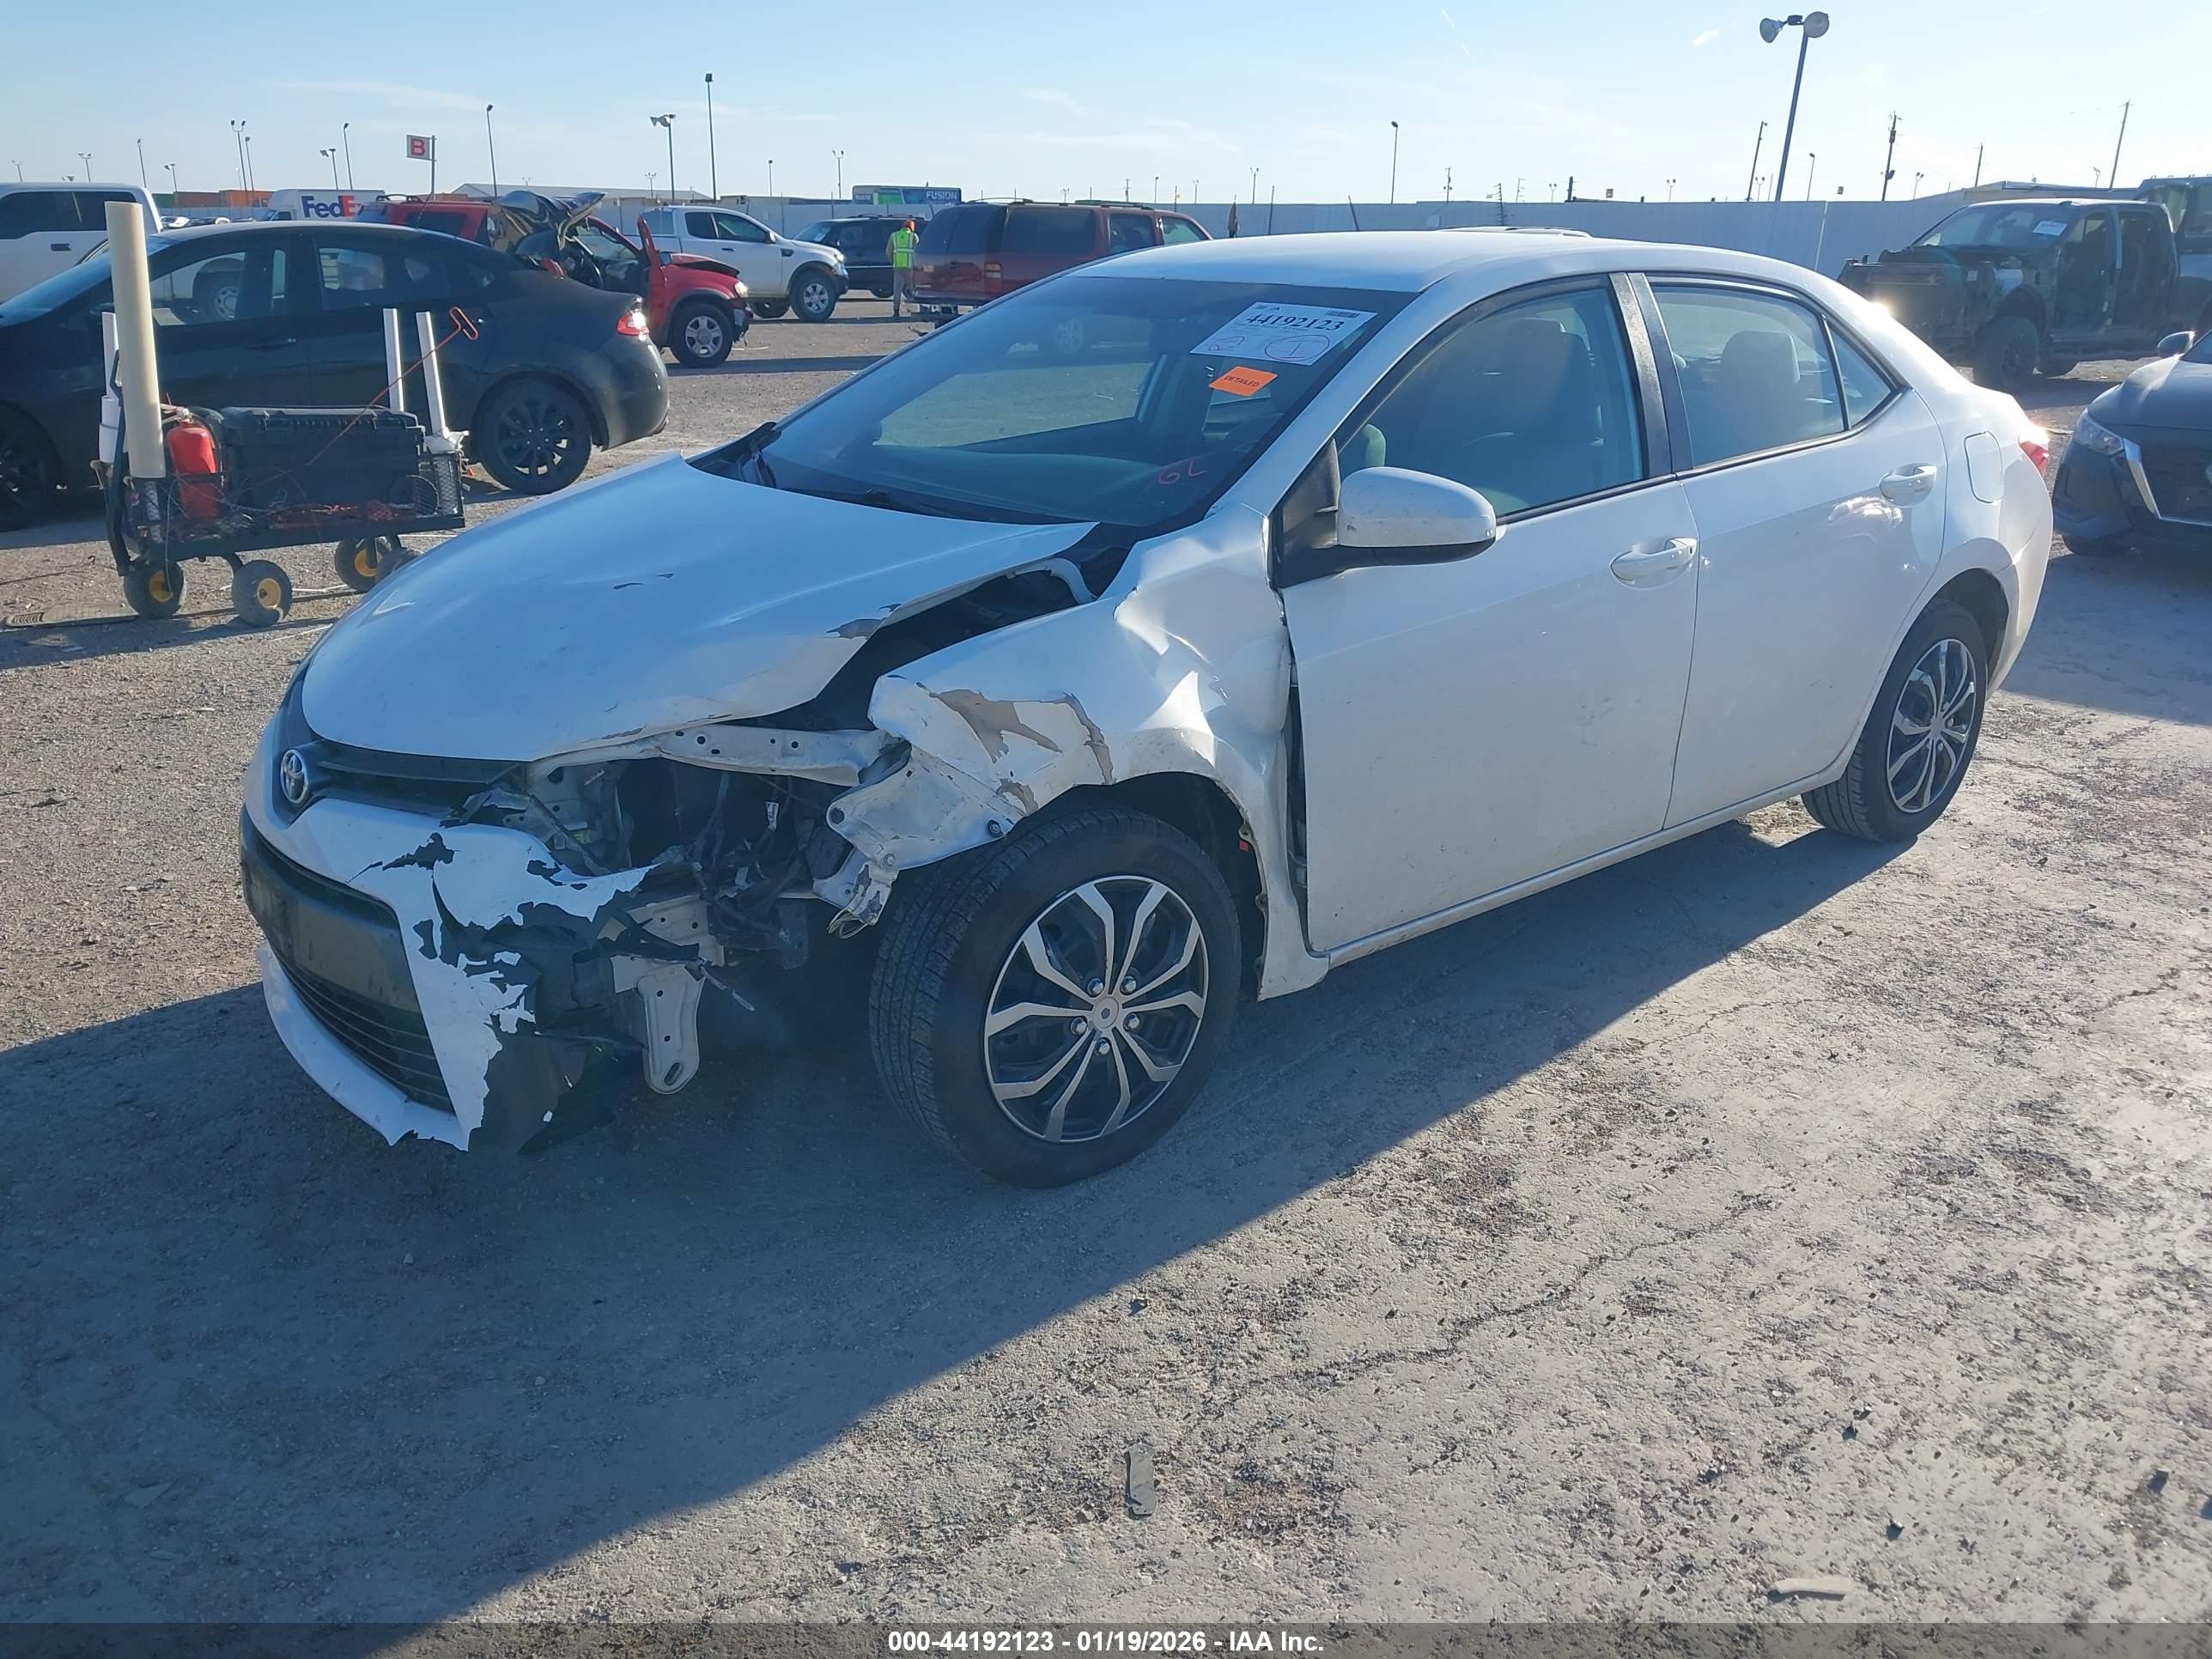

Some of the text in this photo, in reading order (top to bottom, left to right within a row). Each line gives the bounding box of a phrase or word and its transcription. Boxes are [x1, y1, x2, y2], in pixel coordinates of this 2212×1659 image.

[410, 137, 426, 156] B
[926, 191, 957, 200] FUSION
[301, 195, 360, 218] FedE
[1246, 313, 1345, 331] 44192123
[1224, 375, 1260, 388] DETAILED
